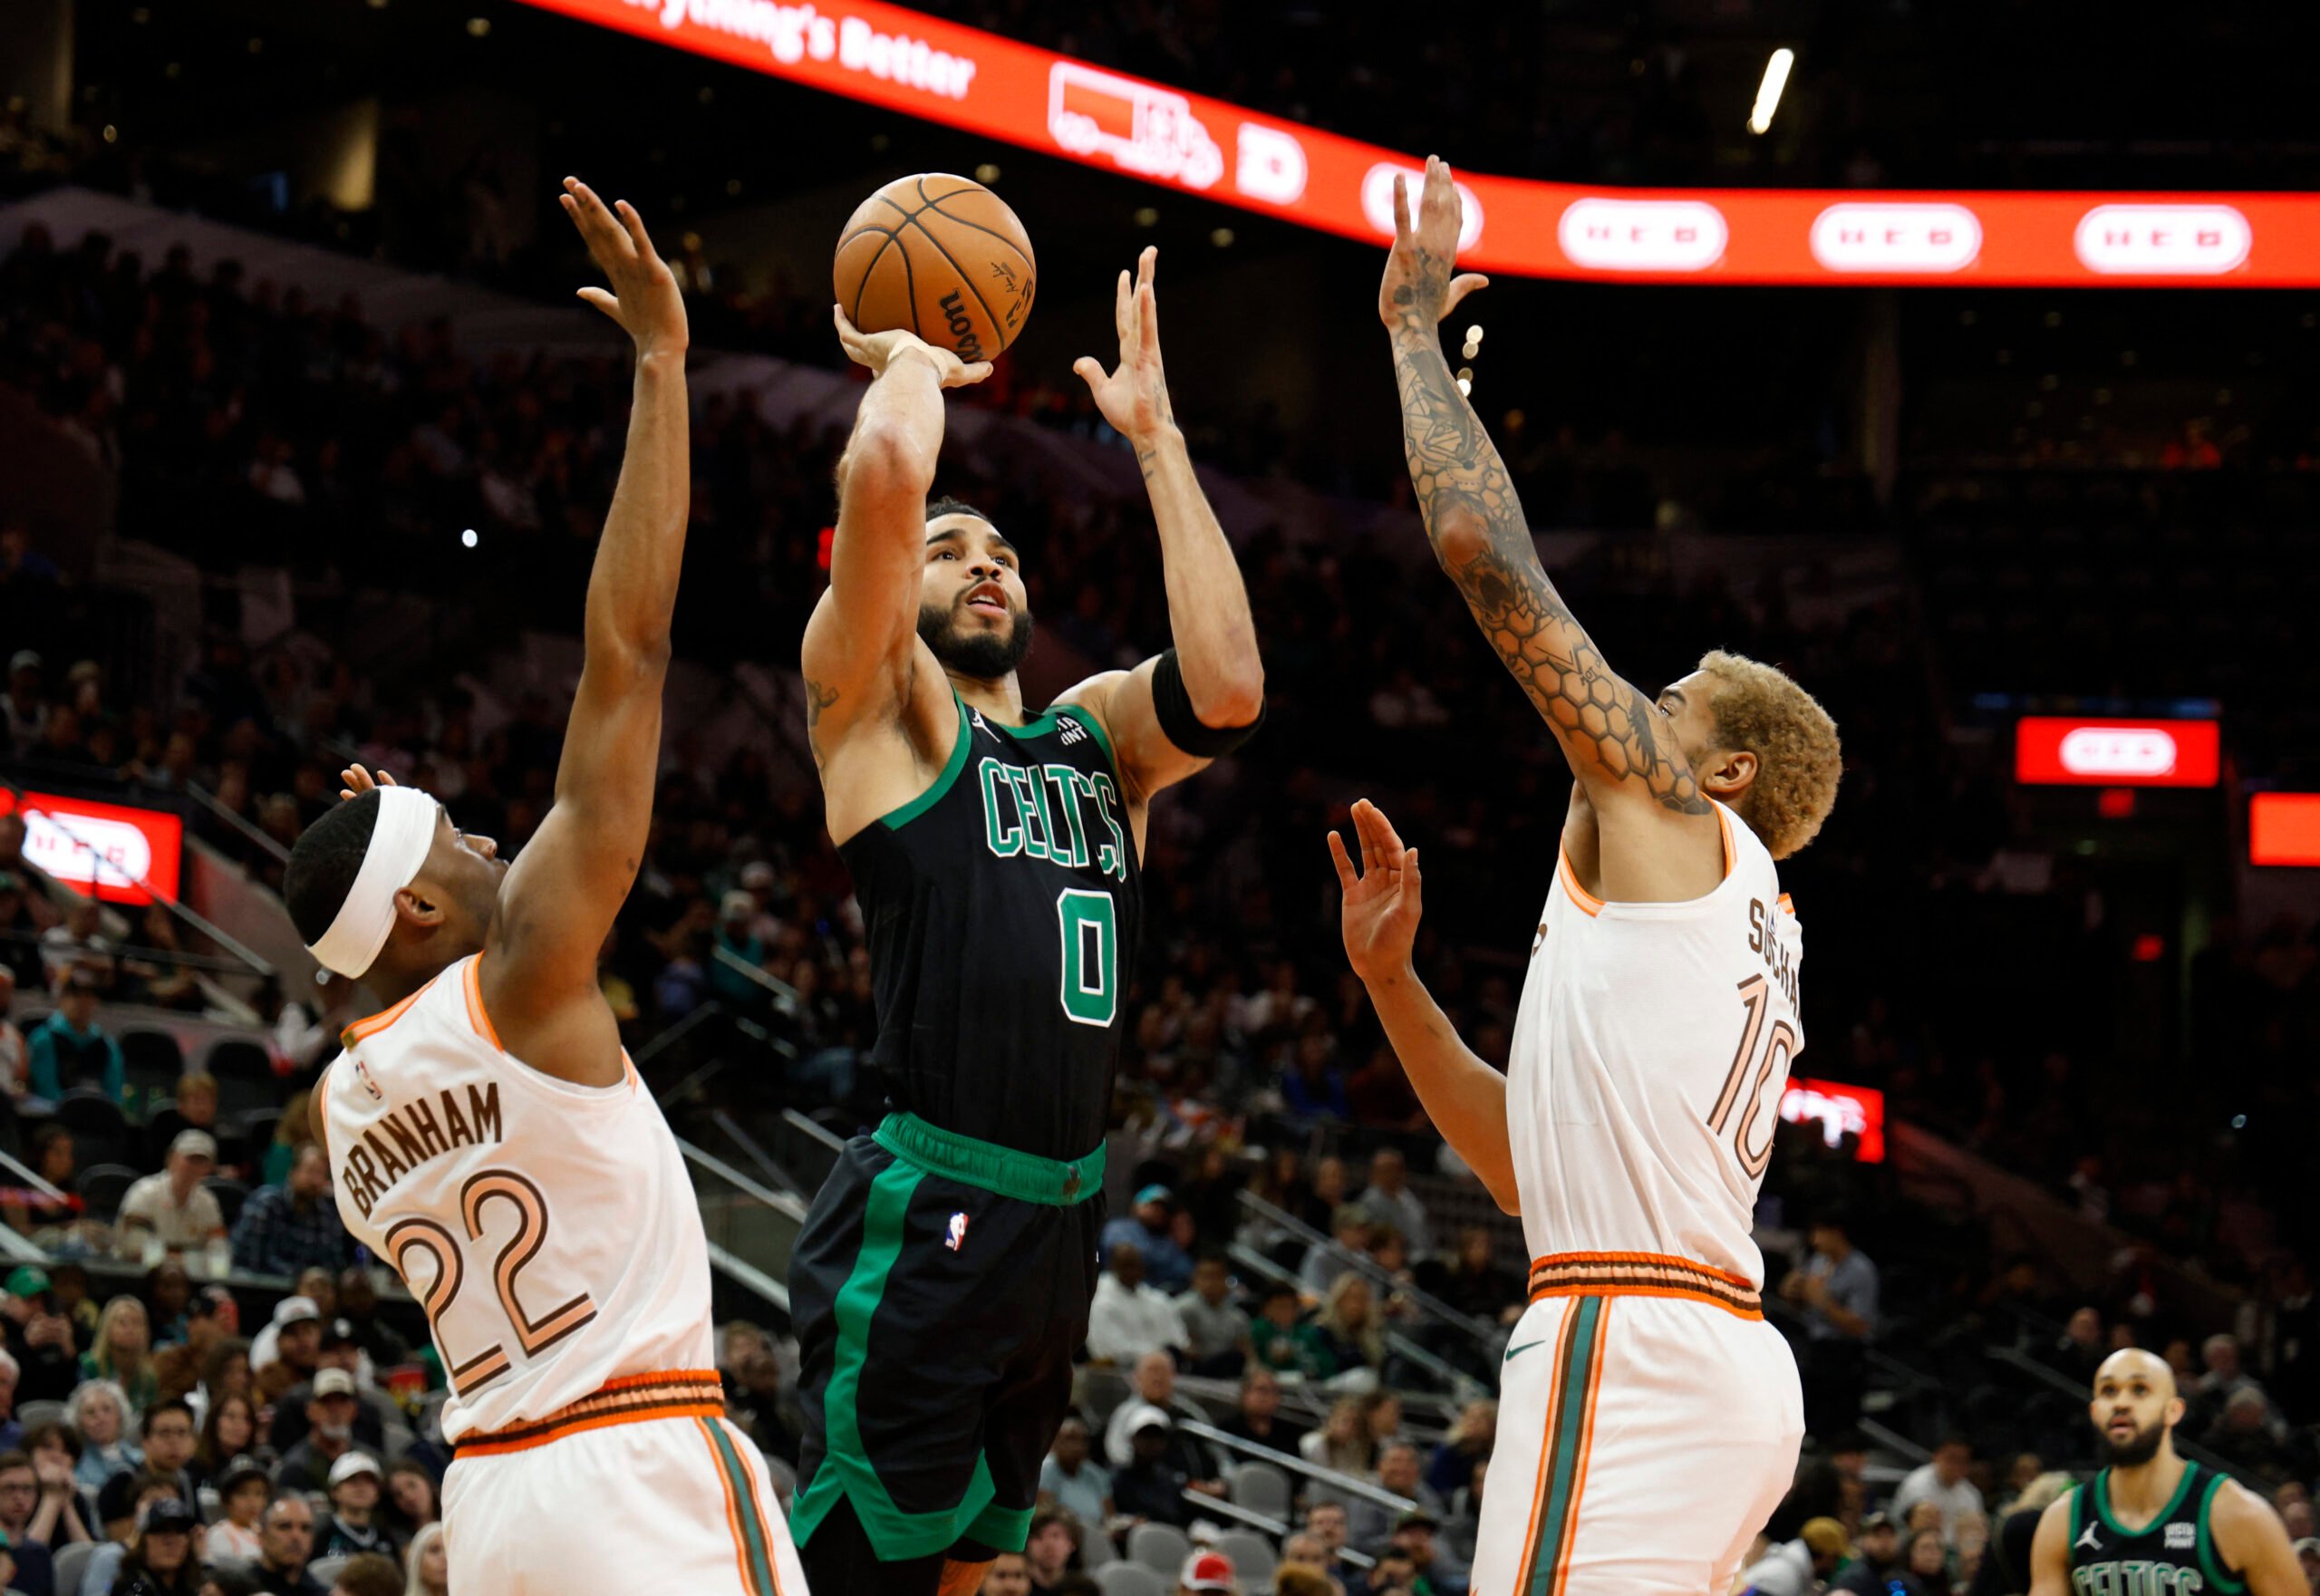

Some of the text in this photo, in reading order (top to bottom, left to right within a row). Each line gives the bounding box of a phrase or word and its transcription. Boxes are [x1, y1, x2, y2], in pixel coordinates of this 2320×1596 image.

[839, 15, 976, 102] Better
[1057, 887, 1117, 1028] 0
[1748, 896, 1801, 1040] SOCHA
[1706, 972, 1794, 1181] 10
[342, 1082, 502, 1221] BRANHAM
[384, 1169, 597, 1398] 22
